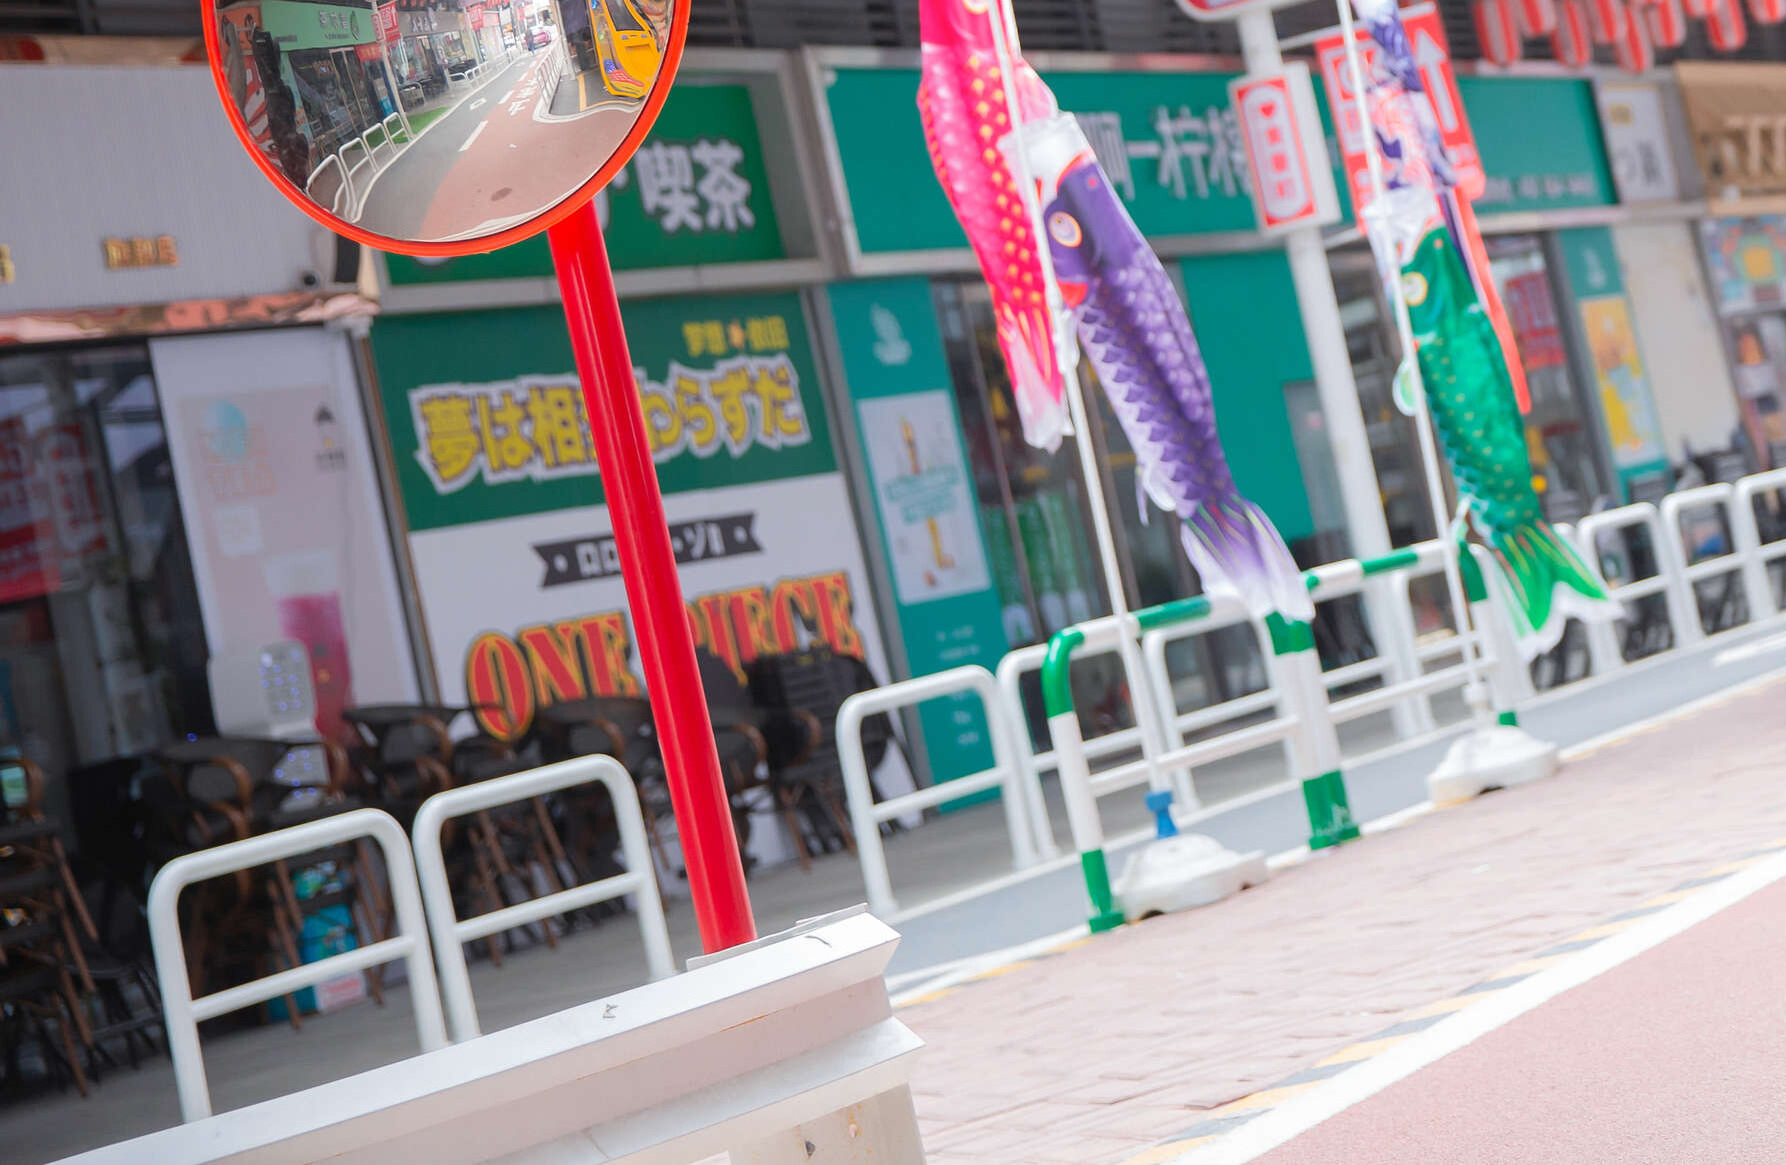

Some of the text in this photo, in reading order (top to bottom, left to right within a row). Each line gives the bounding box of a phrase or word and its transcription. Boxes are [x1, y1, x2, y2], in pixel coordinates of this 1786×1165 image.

[590, 139, 757, 233] 喫茶
[410, 355, 809, 491] 夢は相わらずだ
[466, 570, 867, 743] ONE IECE
